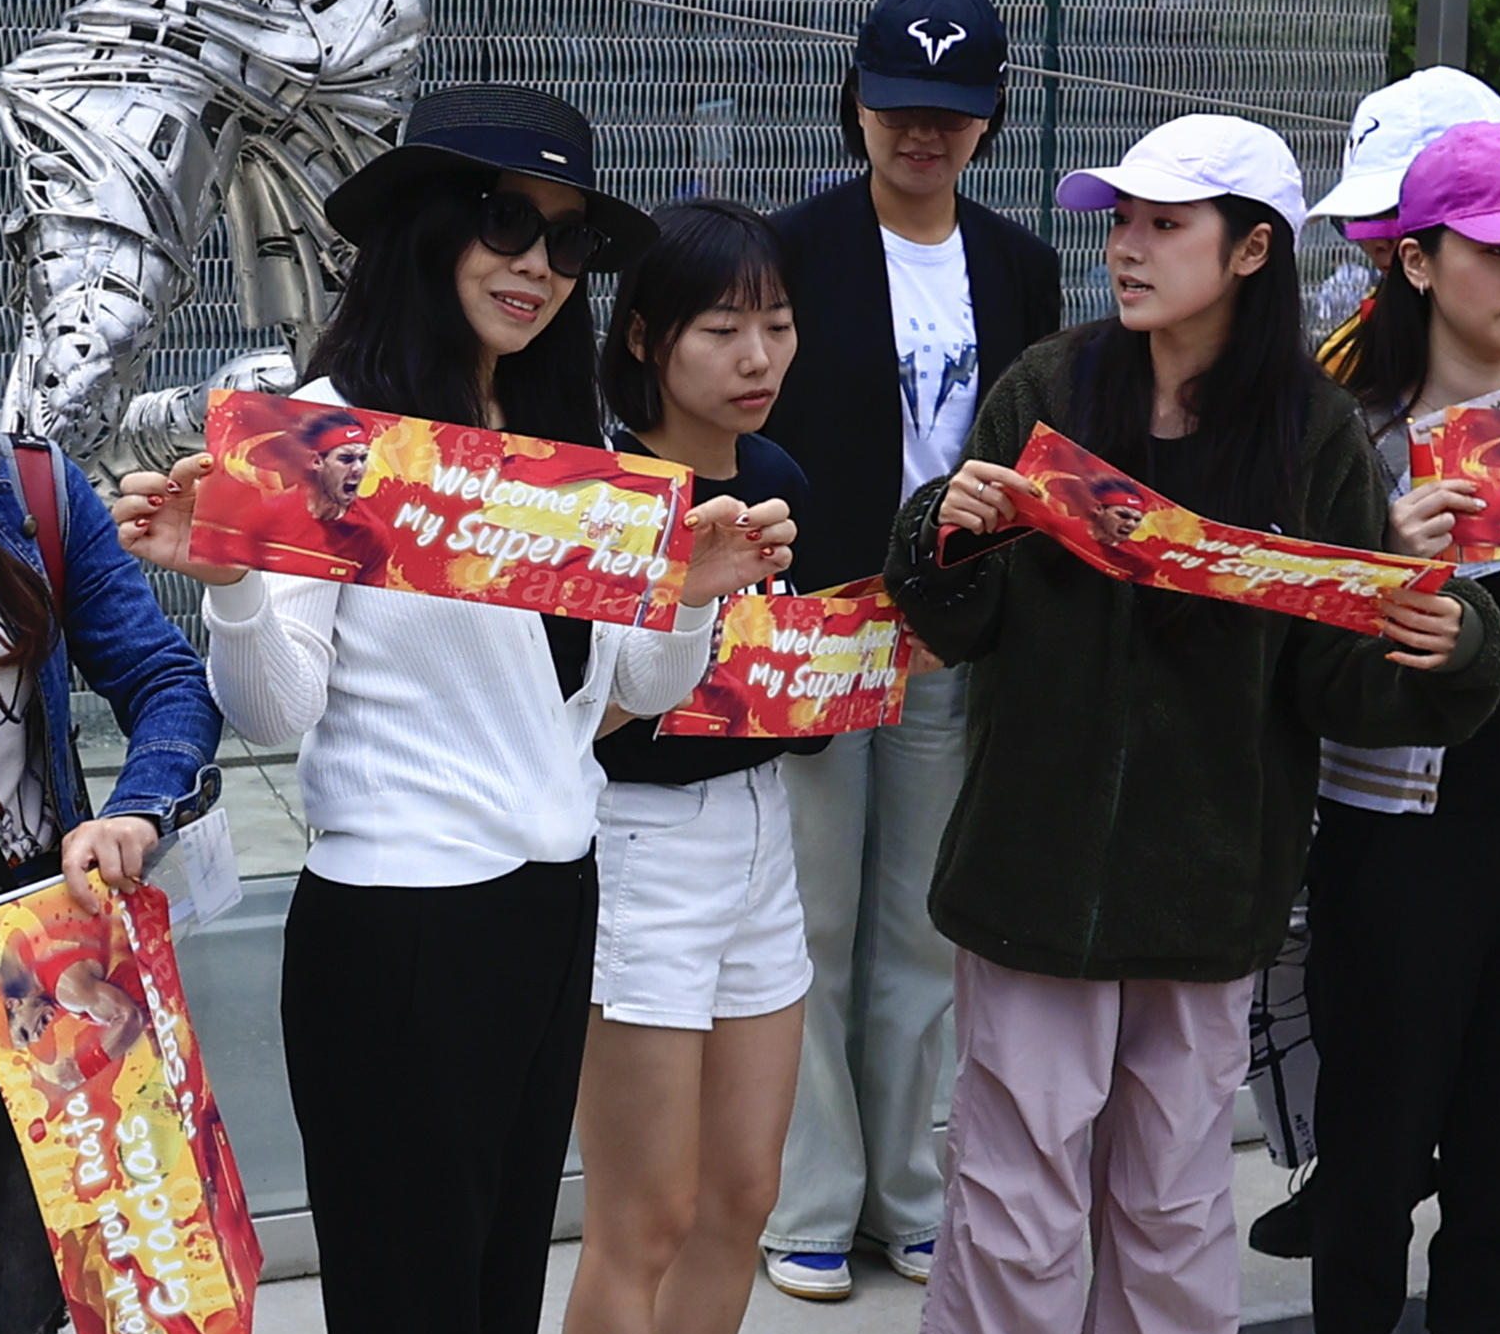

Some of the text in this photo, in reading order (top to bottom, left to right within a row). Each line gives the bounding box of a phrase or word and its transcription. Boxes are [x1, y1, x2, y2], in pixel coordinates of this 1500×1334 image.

[432, 463, 669, 531] Welcome back
[393, 502, 669, 581] My Super hero
[1160, 550, 1205, 569] My
[1207, 556, 1330, 589] Super
[1194, 538, 1330, 568] Welcome
[748, 661, 897, 715] My Super hero
[140, 973, 187, 1087] Super
[63, 1092, 107, 1186] Rafa
[98, 1197, 131, 1261] you
[115, 1111, 189, 1316] Gracias
